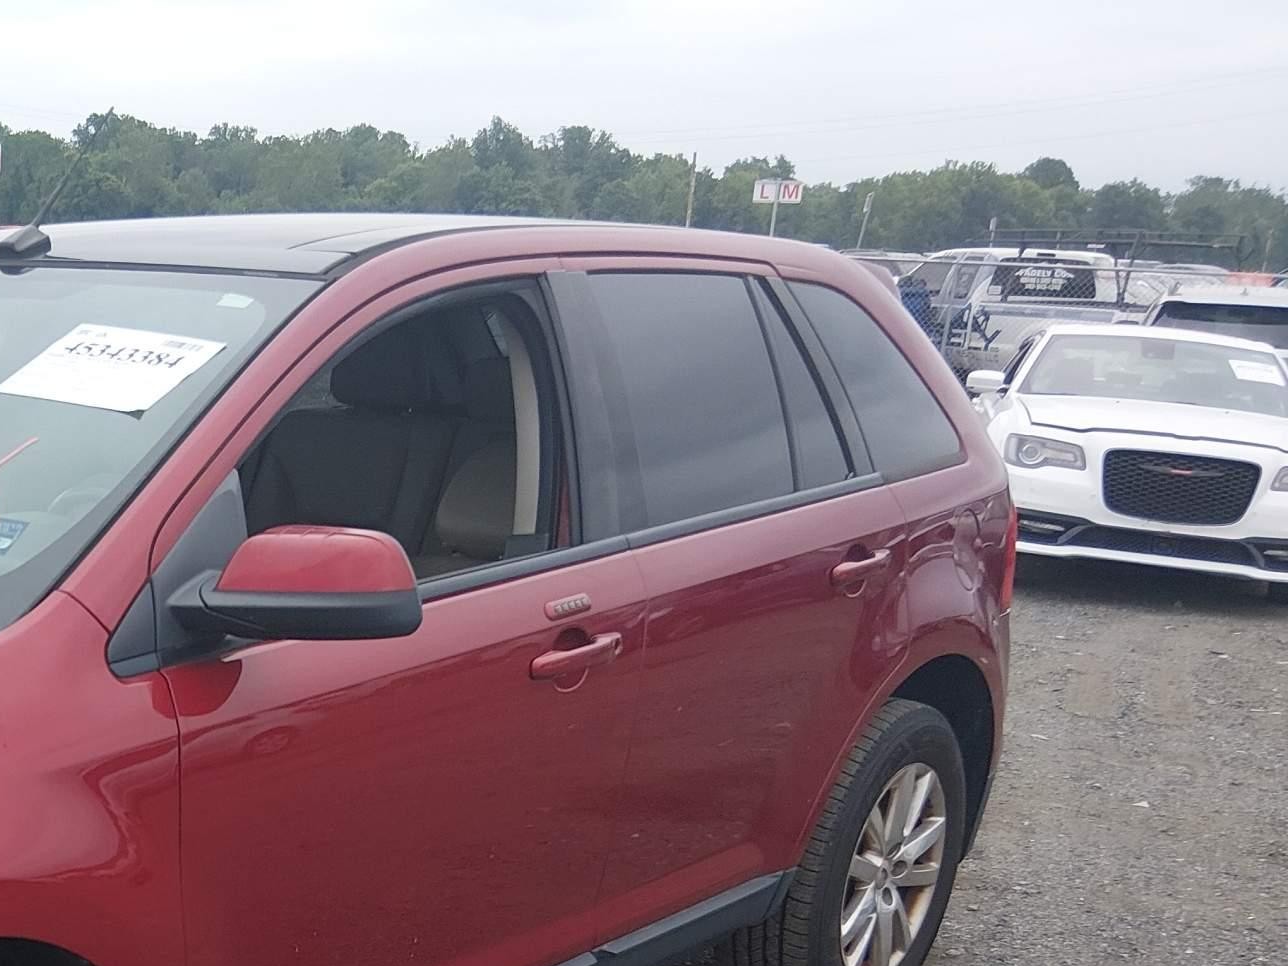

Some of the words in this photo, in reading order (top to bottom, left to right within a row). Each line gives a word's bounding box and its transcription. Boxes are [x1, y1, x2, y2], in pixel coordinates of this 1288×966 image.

[760, 184, 769, 199] L
[782, 184, 799, 199] M
[65, 342, 184, 368] 45343384
